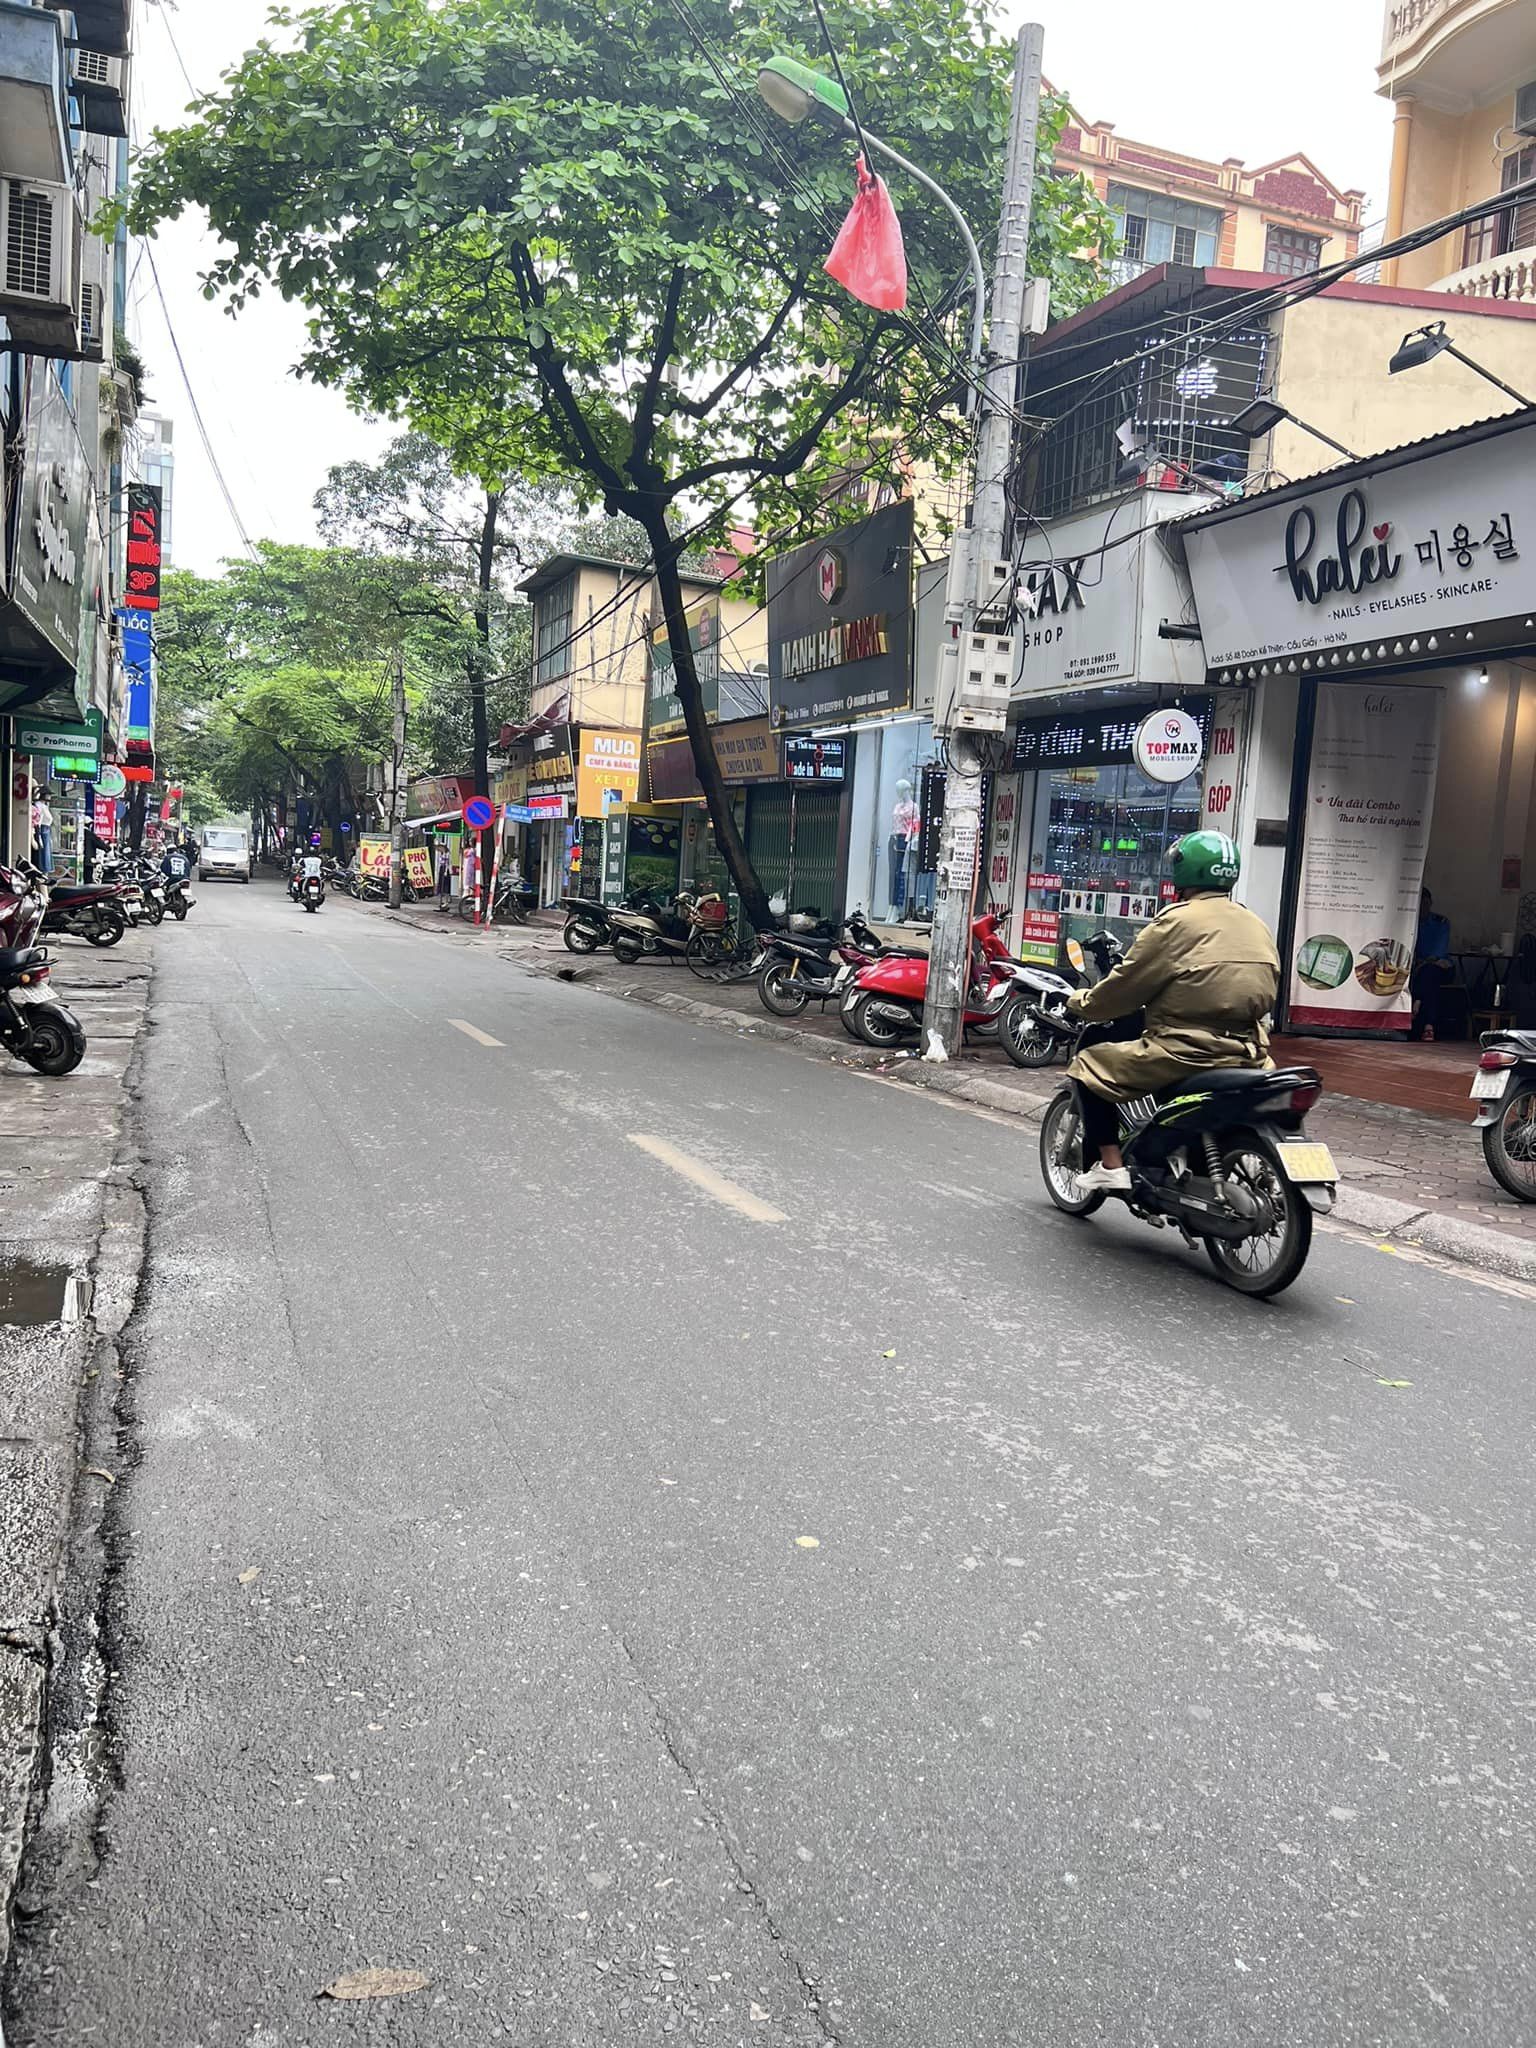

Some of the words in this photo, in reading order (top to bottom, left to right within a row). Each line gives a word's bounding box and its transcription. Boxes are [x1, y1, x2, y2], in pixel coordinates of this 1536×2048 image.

[1415, 513, 1520, 577] 미용실
[130, 571, 156, 591] 3P
[1333, 605, 1361, 620] NAILS
[1369, 592, 1427, 613] EYELASHES
[1437, 579, 1493, 600] SKINCARE
[1024, 626, 1063, 648] SHOP
[44, 736, 92, 748] ProPharma
[594, 736, 635, 755] MUA
[1146, 742, 1198, 755] TOPMAX
[1208, 779, 1232, 813] GÓP
[1366, 799, 1401, 811] Combo
[407, 848, 427, 863] PHỞ
[1210, 864, 1239, 877] Grab
